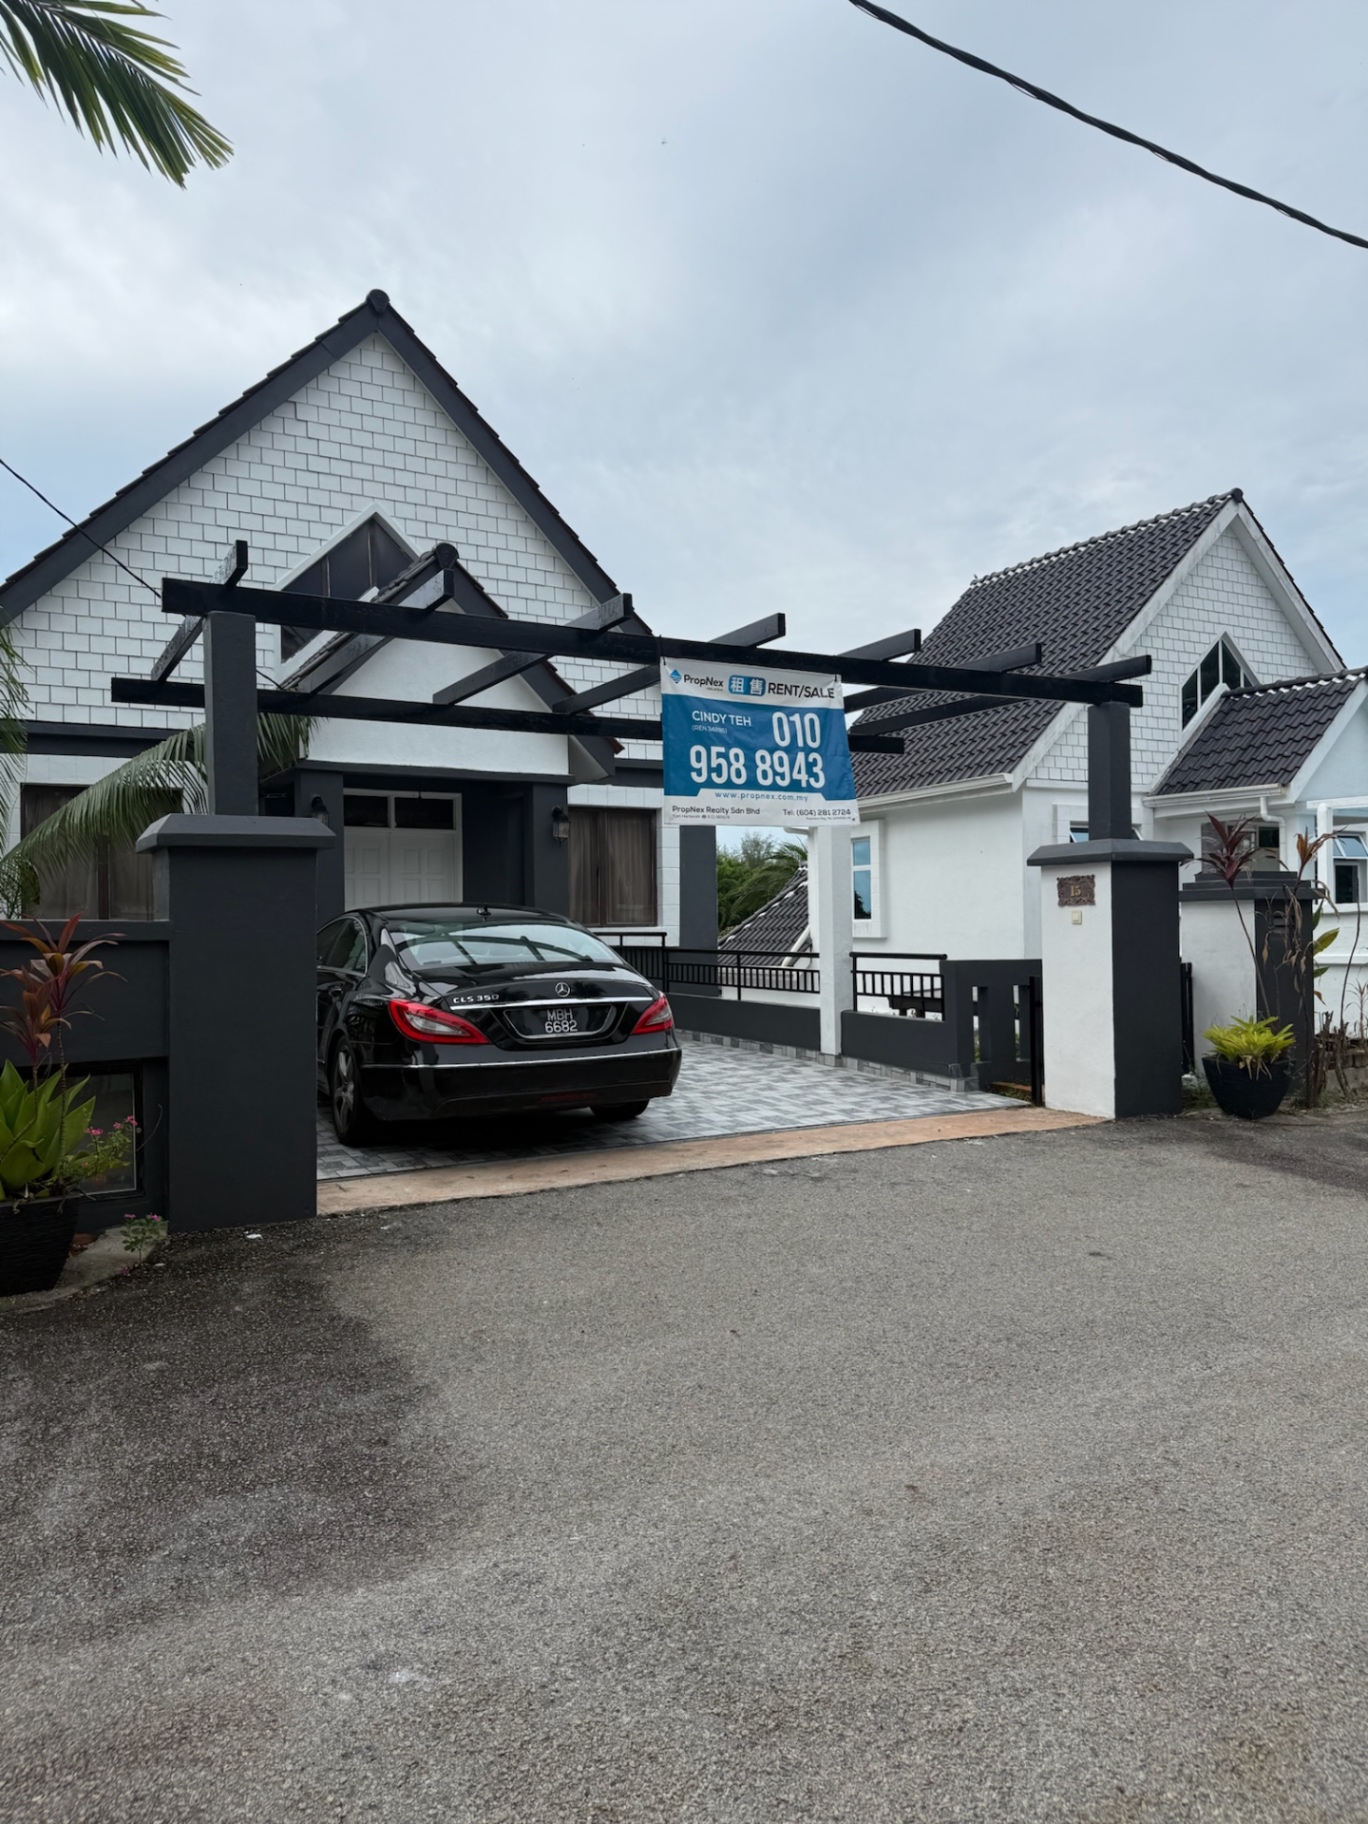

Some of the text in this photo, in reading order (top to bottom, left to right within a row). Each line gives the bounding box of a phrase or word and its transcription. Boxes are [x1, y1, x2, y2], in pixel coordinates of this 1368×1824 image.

[683, 674, 724, 687] PropNex
[730, 676, 764, 696] 租售
[767, 682, 835, 699] RENT/SALE
[691, 710, 752, 727] CINDY TEH
[772, 711, 821, 749] 010
[689, 744, 826, 789] 958 8943
[714, 791, 808, 802] www.propnex.com.my
[672, 805, 761, 815] PropNex Realty Sdn Bhd
[796, 808, 817, 817] (604)
[1070, 885, 1081, 897] 15
[453, 993, 500, 1004] CLS 350
[546, 1007, 574, 1021] MBH
[544, 1020, 578, 1033] 6682
